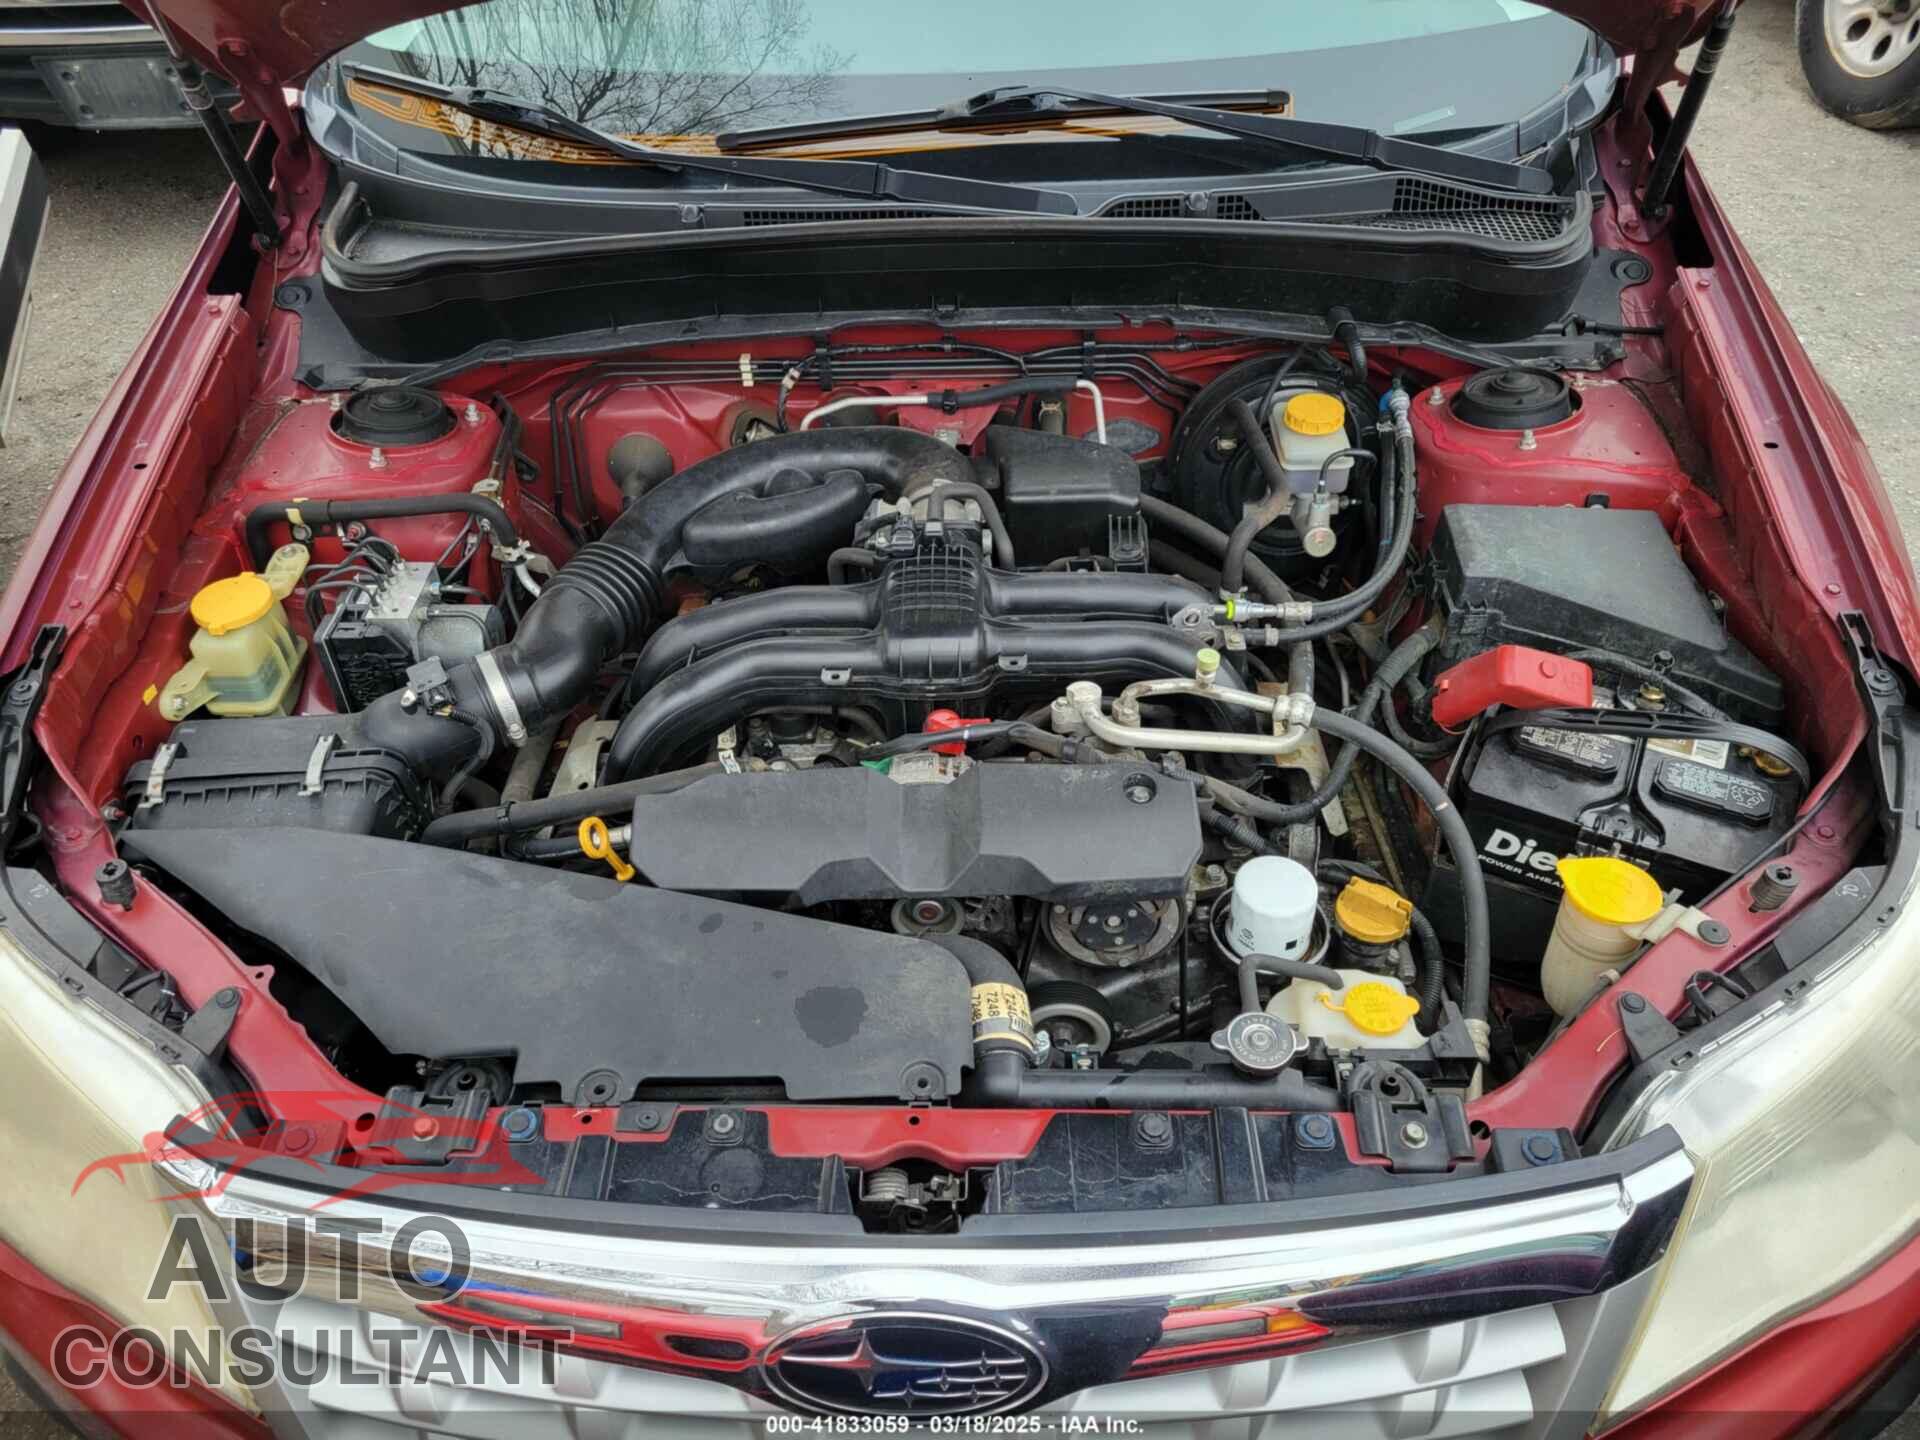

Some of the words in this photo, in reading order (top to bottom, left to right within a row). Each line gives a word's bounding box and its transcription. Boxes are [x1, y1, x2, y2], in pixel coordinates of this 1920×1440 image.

[1484, 828, 1560, 872] Die
[1478, 854, 1523, 875] POWER
[1525, 871, 1566, 890] AHEA
[987, 992, 1000, 1017] 7248
